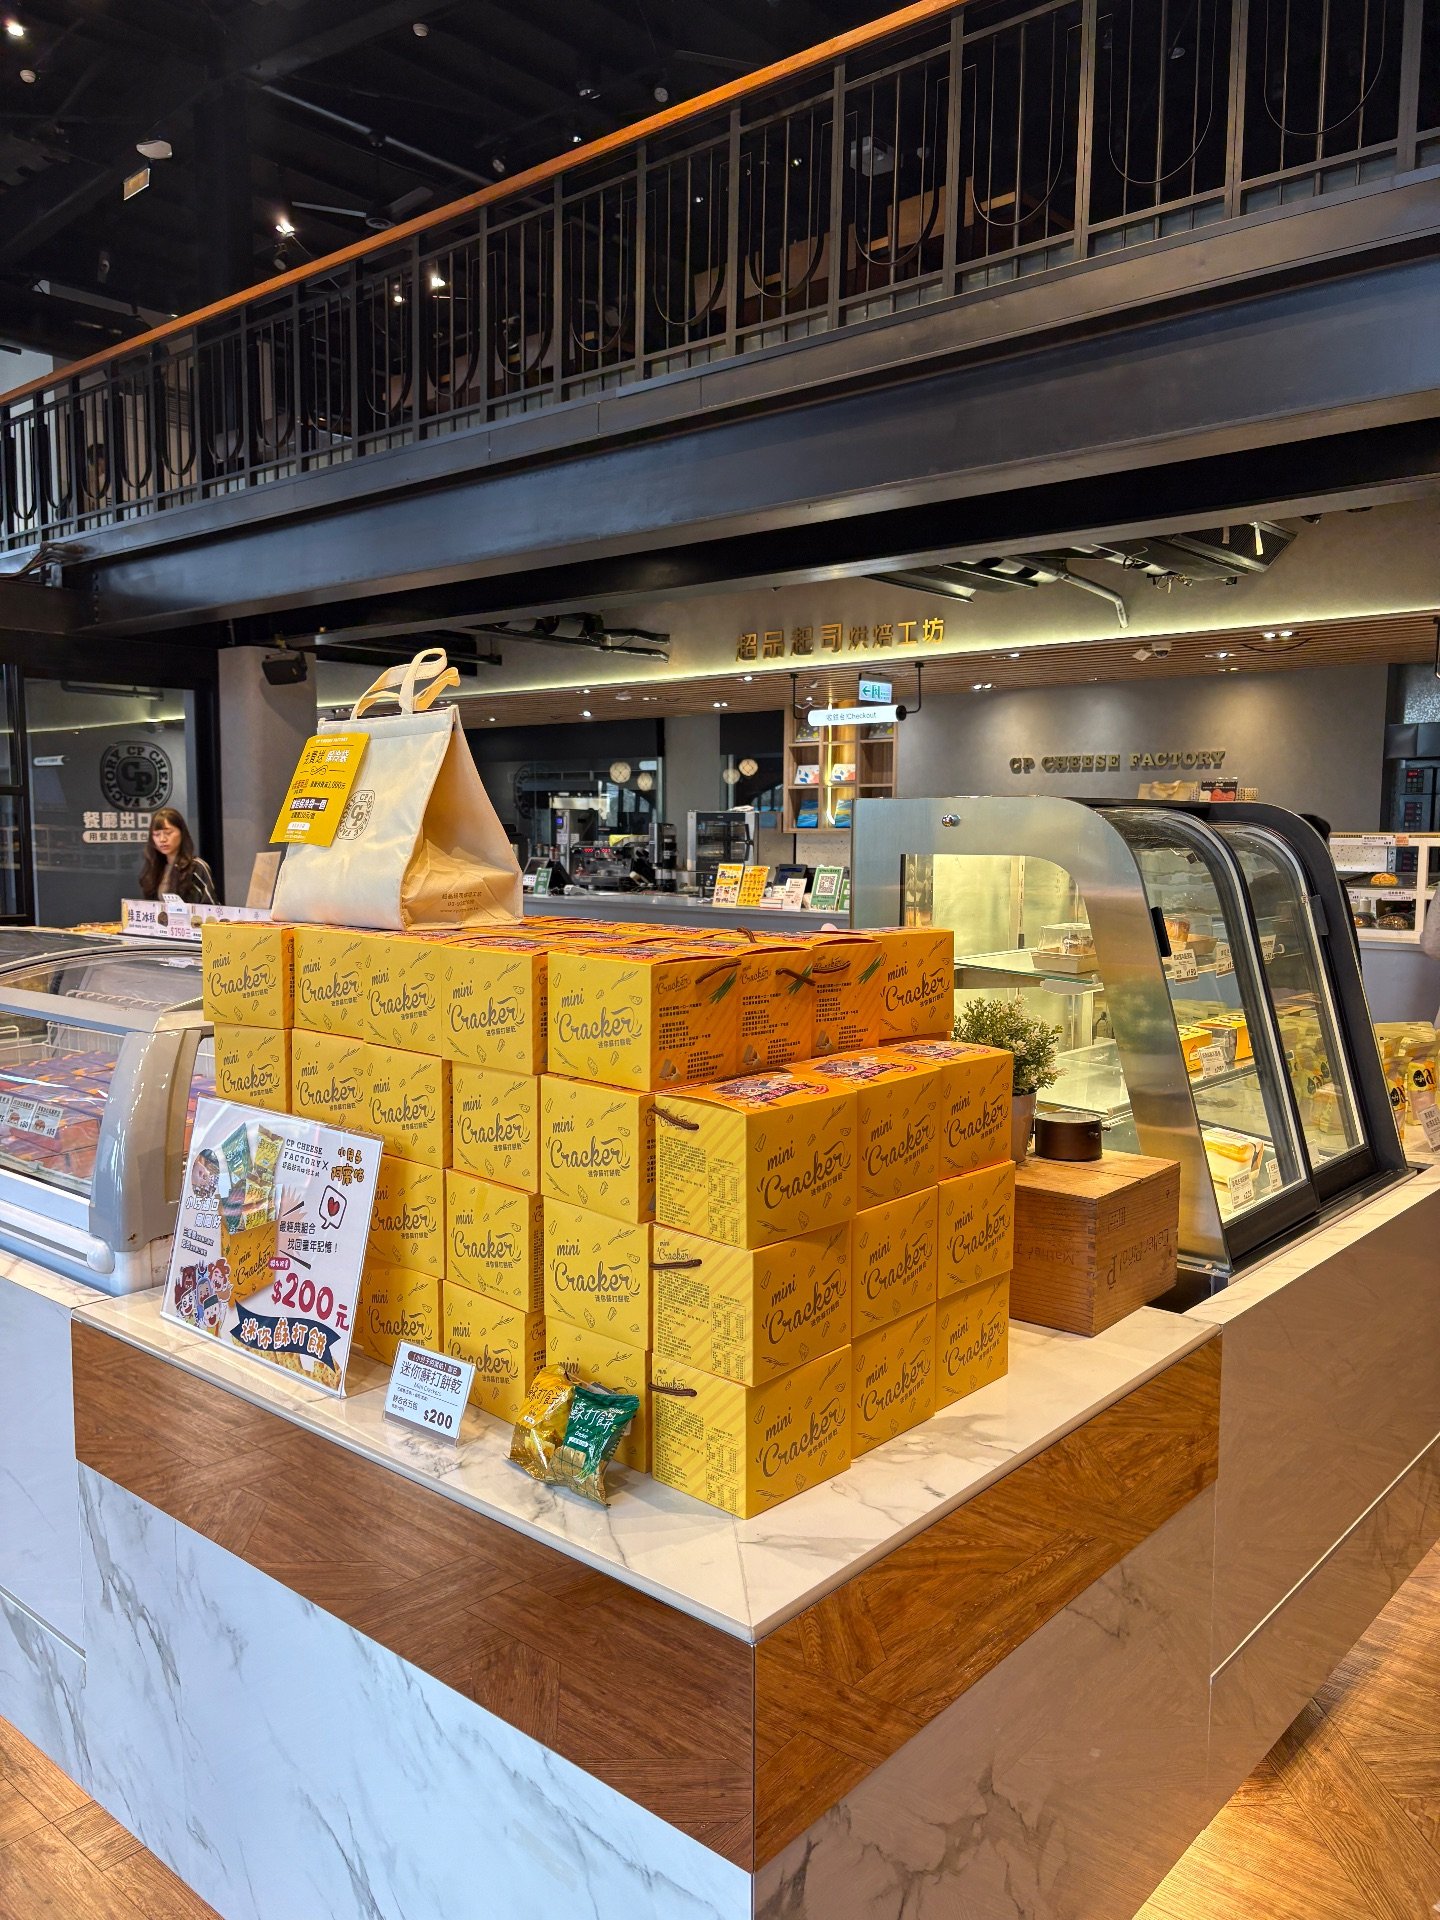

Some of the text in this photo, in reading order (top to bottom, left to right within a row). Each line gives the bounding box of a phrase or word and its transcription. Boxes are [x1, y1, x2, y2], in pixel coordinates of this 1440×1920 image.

[736, 618, 944, 662] 超品起司烘焙工坊
[127, 746, 145, 755] CP
[1009, 751, 1226, 772] CP CHEESE FACTORY
[105, 749, 141, 807] FACTORY
[121, 762, 153, 792] CP
[149, 751, 168, 806] CHEESE
[83, 812, 152, 828] 餐廳出口
[351, 804, 364, 826] CP
[212, 952, 231, 969] mini
[303, 957, 321, 974] mini
[887, 961, 908, 982] mini
[211, 964, 270, 997] Cracker
[301, 971, 359, 1003] Cracker
[371, 968, 389, 986] mini
[452, 980, 473, 999] mini
[657, 974, 690, 995] Cracker
[741, 966, 771, 985] Cracker
[885, 968, 946, 1011] Cracker
[370, 982, 429, 1016] Cracker
[561, 988, 584, 1008] mini
[451, 996, 518, 1032] Cracker
[559, 1006, 635, 1043] Cracker
[223, 1050, 239, 1066] mini
[301, 1061, 318, 1077] mini
[221, 1063, 275, 1093] Cracker
[300, 1076, 357, 1106] Cracker
[373, 1076, 390, 1093] mini
[371, 1094, 430, 1125] Cracker
[462, 1094, 482, 1112] mini
[951, 1091, 971, 1116] mini
[461, 1113, 524, 1144] Cracker
[553, 1115, 575, 1133] mini
[871, 1114, 893, 1142] mini
[949, 1094, 1007, 1147] Cracker
[284, 1151, 321, 1167] FACTORY
[297, 1140, 323, 1154] CHEESE
[551, 1136, 623, 1168] Cracker
[767, 1140, 795, 1171] mini
[868, 1114, 931, 1176] Cracker
[764, 1141, 848, 1209] Cracker
[374, 1185, 389, 1200] ini
[280, 1221, 316, 1234] 最經典組合
[370, 1204, 430, 1231] Cracker
[455, 1209, 474, 1225] mini
[954, 1205, 974, 1232] mini
[455, 1230, 516, 1258] Cracker
[556, 1239, 580, 1256] mini
[952, 1204, 1009, 1263] Cracker
[659, 1248, 690, 1260] Cracker
[869, 1235, 891, 1266] mini
[555, 1261, 633, 1292] Cracker
[867, 1233, 930, 1299] Cracker
[371, 1290, 388, 1304] mini
[771, 1274, 797, 1307] mini
[768, 1269, 843, 1344] Cracker
[371, 1309, 426, 1336] Cracker
[453, 1322, 471, 1338] mini
[950, 1317, 969, 1345] mini
[240, 1317, 327, 1358] 迷你蘇打餅
[948, 1312, 1002, 1376] Cracker
[400, 1361, 463, 1394] 迷你蘇打餅乾
[655, 1374, 686, 1390] Cracker
[864, 1350, 928, 1421] Cracker
[866, 1357, 888, 1388] mini
[423, 1409, 452, 1429] $200
[766, 1407, 793, 1441] mini
[763, 1398, 841, 1478] Cracker
